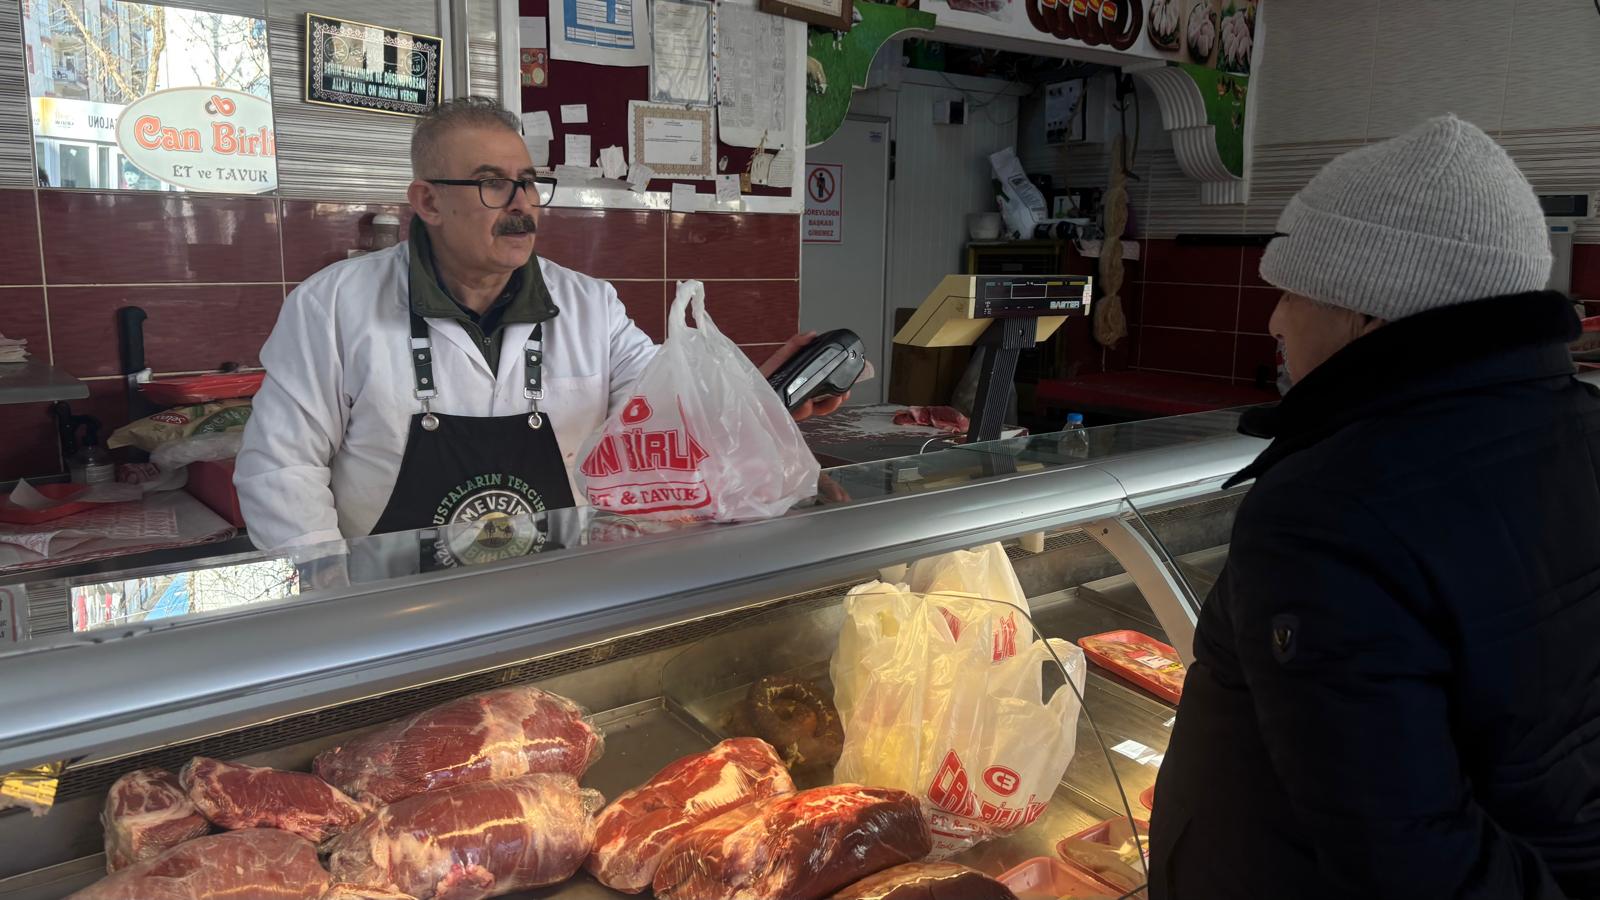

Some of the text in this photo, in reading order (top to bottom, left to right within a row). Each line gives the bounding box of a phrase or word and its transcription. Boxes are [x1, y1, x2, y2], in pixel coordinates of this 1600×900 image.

[332, 77, 349, 92] ALLAH
[351, 81, 366, 95] SANA
[134, 115, 202, 153] Can
[173, 165, 269, 182] ET ve TAVUK
[432, 473, 502, 525] USTALARIN
[620, 491, 637, 505] &
[640, 487, 699, 503] TAVUK
